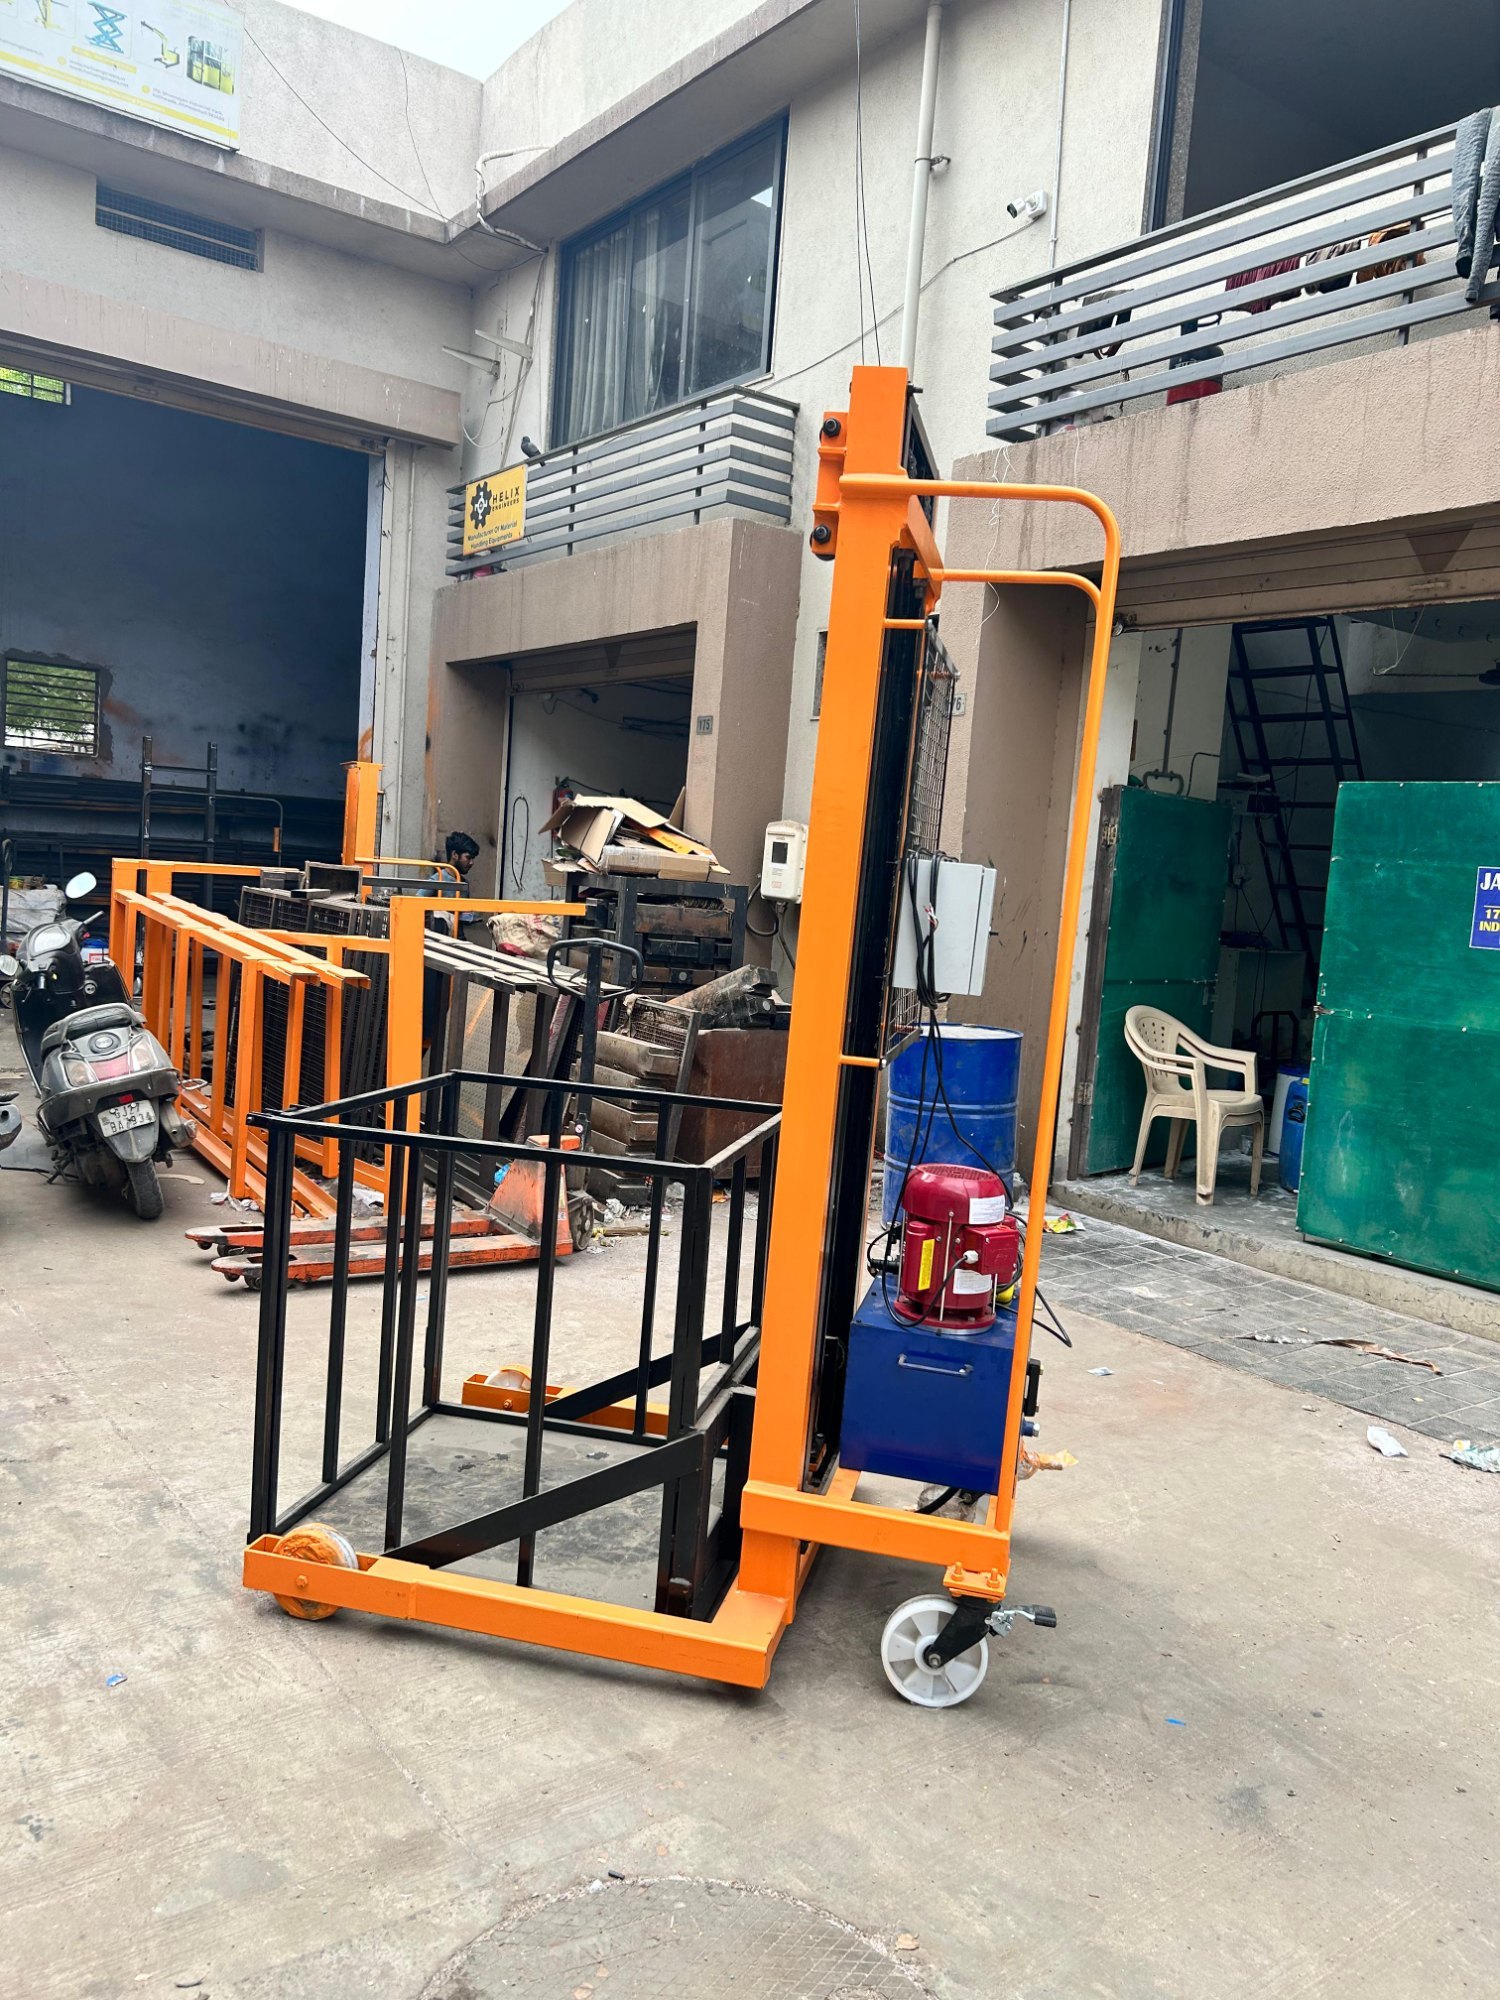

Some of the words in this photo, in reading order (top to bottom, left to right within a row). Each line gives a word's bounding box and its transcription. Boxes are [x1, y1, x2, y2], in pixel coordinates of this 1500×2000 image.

[492, 486, 520, 505] HELIX
[492, 497, 520, 512] ENGINEERS
[699, 718, 710, 731] 175
